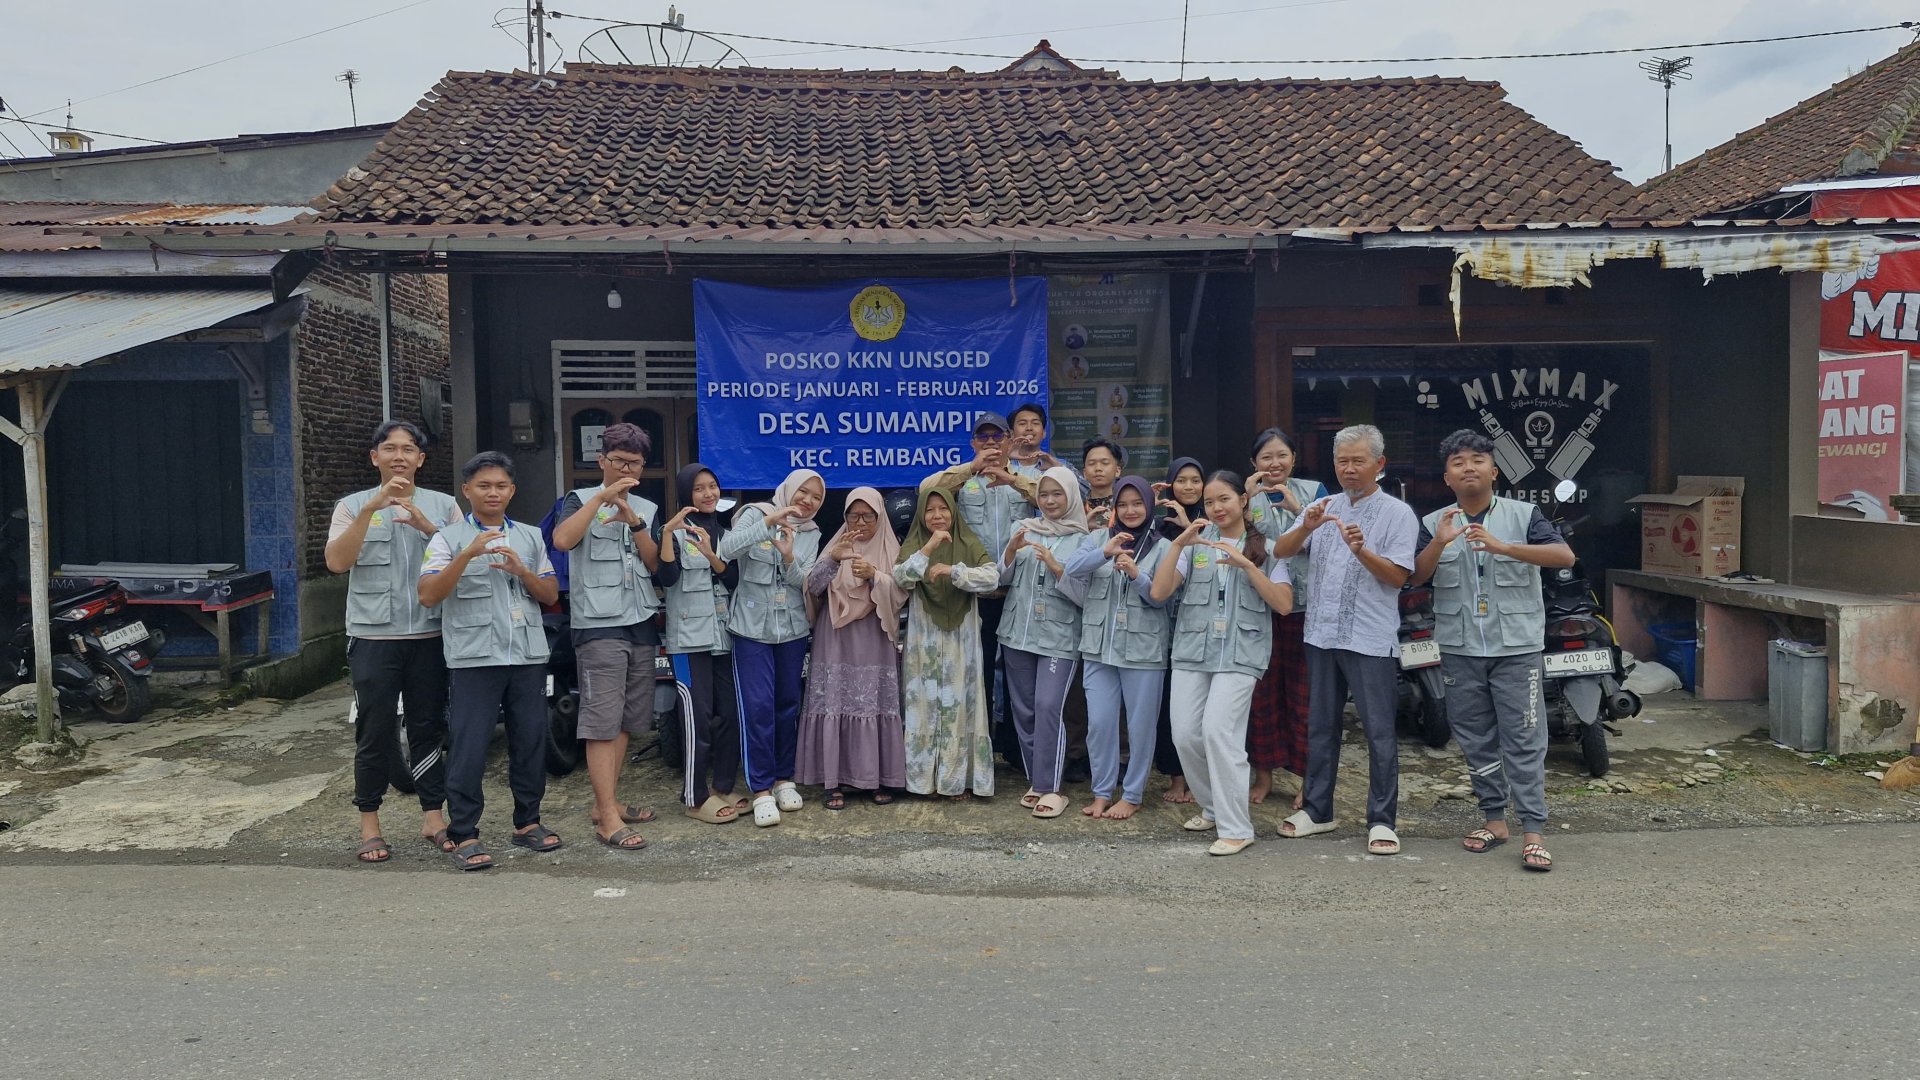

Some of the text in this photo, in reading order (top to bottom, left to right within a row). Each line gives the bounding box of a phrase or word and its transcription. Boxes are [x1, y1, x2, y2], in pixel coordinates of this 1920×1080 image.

[765, 351, 990, 369] POSKO KKN UNSOED
[707, 382, 790, 398] PERIODE
[794, 381, 879, 401] JANUARI
[897, 381, 989, 396] FEBRUARI
[995, 380, 1039, 396] 2026
[1461, 367, 1619, 411] MIXMAX
[1818, 368, 1866, 401] AT
[758, 412, 830, 435] DESA
[789, 447, 961, 468] KEC. REMBANG
[1410, 641, 1434, 654] 6095
[1546, 657, 1553, 666] R
[1562, 653, 1589, 664] 4020
